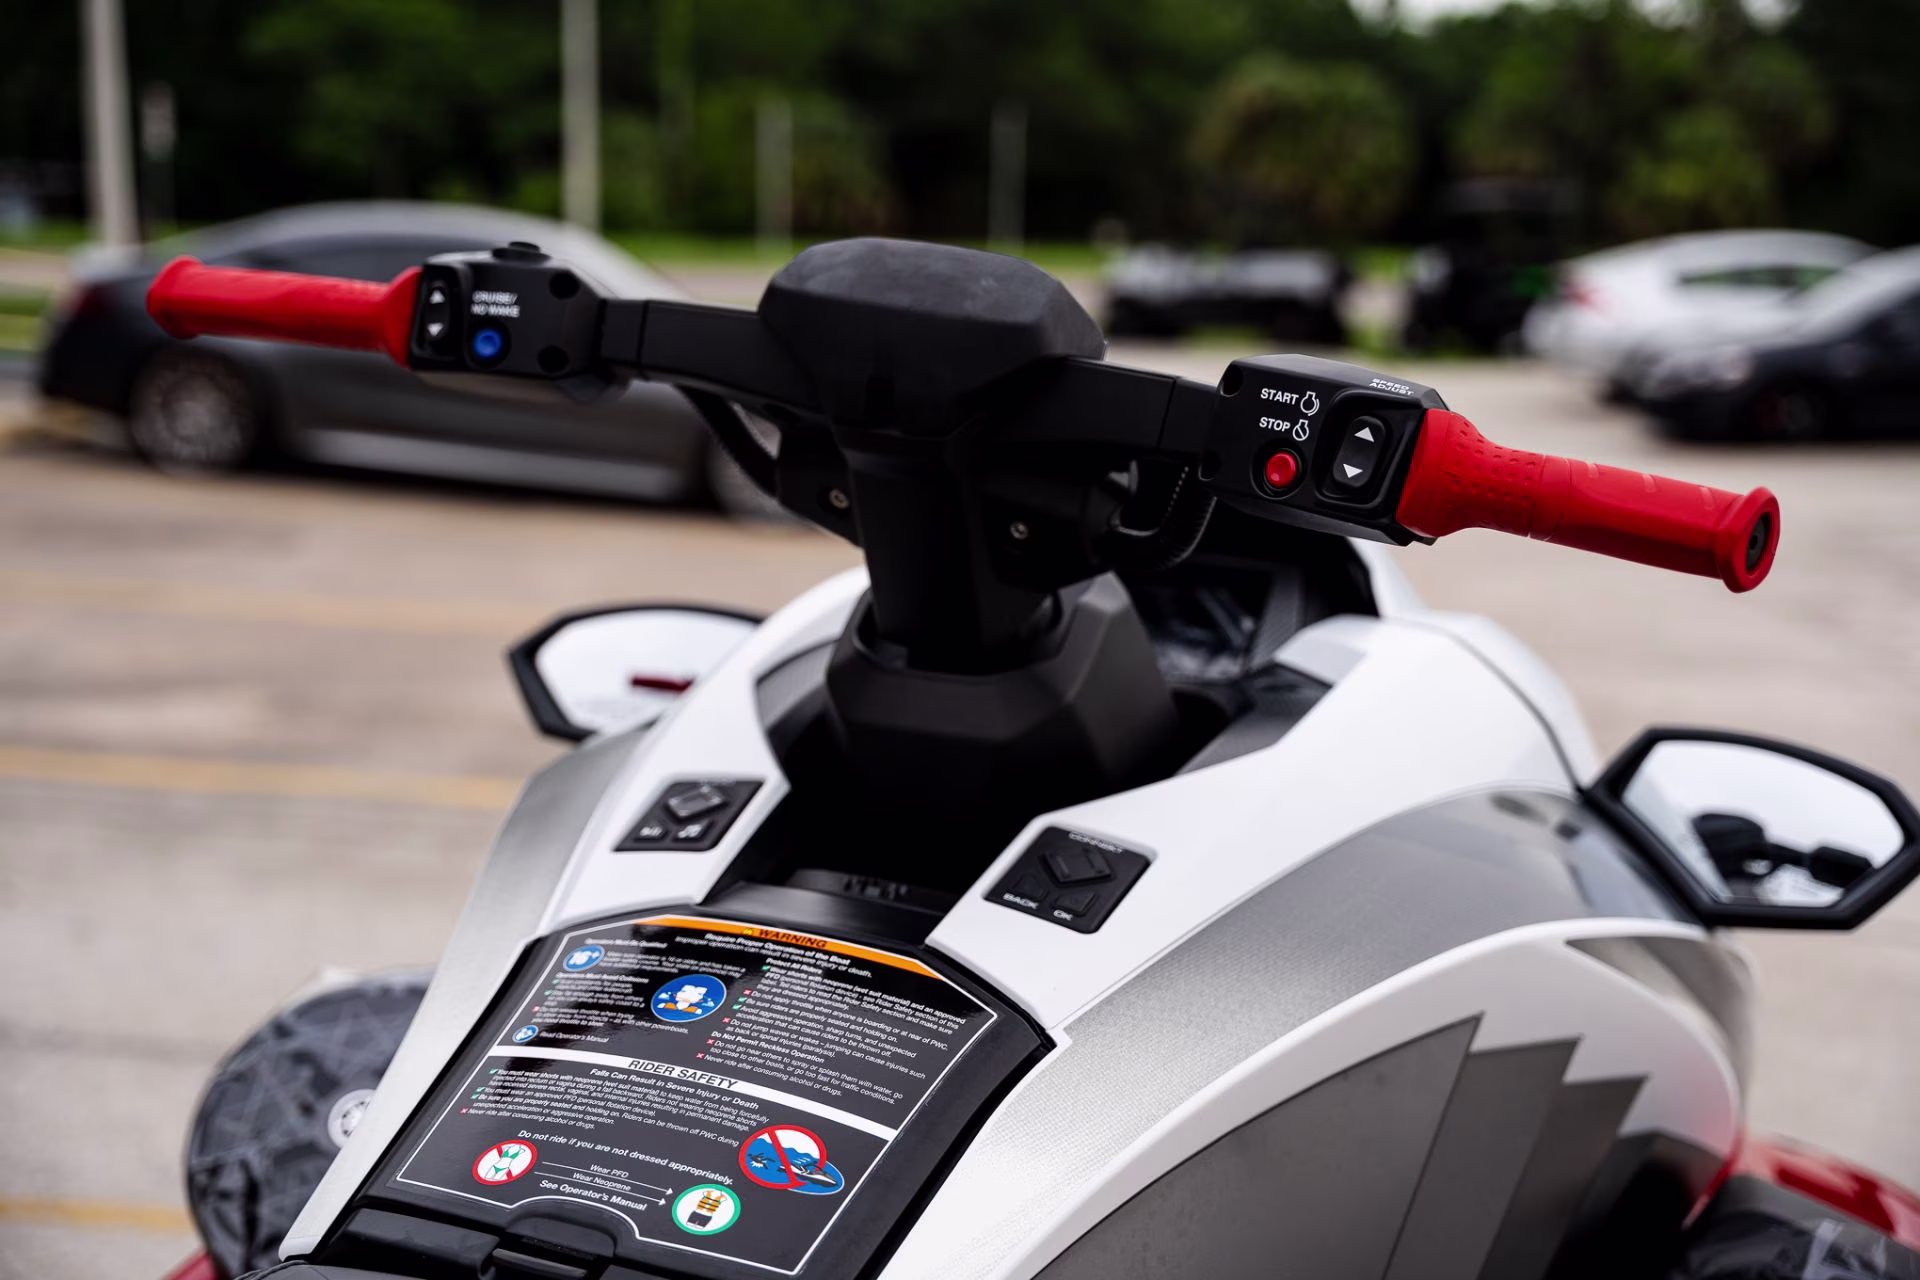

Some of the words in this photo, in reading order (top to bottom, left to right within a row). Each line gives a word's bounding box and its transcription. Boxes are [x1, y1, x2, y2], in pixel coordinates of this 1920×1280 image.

[472, 290, 517, 304] CRUISE/
[471, 303, 488, 315] NO
[489, 304, 520, 317] WAKE
[1261, 388, 1299, 405] START
[1369, 383, 1414, 395] ADJUST
[1372, 379, 1409, 390] SPEED
[1259, 417, 1291, 432] STOP
[1003, 893, 1039, 909] BACK
[1053, 910, 1073, 921] OK
[704, 932, 736, 943] Require
[735, 936, 764, 947] Proper
[763, 941, 805, 955] Operation
[814, 951, 829, 960] the
[828, 954, 851, 965] Boat
[757, 929, 828, 949] WARNING
[750, 990, 762, 998] Do
[772, 995, 791, 1005] apply
[790, 999, 814, 1009] throttle
[813, 1005, 832, 1014] when
[831, 1010, 856, 1020] anyone
[862, 1017, 892, 1032] boarding
[907, 1032, 922, 1041] rear
[929, 1039, 948, 1051] PWC.
[710, 1030, 722, 1038] Do
[721, 1032, 736, 1041] Not
[734, 1035, 759, 1046] Permit
[757, 1041, 790, 1053] Reckless
[790, 1048, 825, 1063] Operation
[627, 1059, 675, 1075] RIDER
[677, 1068, 738, 1088] SAFETY
[703, 1053, 724, 1063] Never
[736, 1062, 753, 1070] after
[752, 1066, 789, 1081] consuming
[788, 1075, 814, 1086] alcohol
[821, 1085, 842, 1096] drugs.
[709, 1046, 722, 1054] too
[720, 1049, 740, 1058] close
[738, 1052, 748, 1060] to
[746, 1055, 765, 1064] other
[793, 1067, 805, 1075] go
[803, 1070, 817, 1078] too
[816, 1073, 830, 1082] fast
[829, 1077, 841, 1085] for
[840, 1081, 860, 1092] traffic
[859, 1088, 895, 1104] conditions.
[713, 1039, 725, 1047] Do
[745, 1047, 762, 1055] near
[760, 1051, 783, 1061] others
[790, 1059, 810, 1069] spray
[817, 1066, 840, 1077] splash
[839, 1073, 858, 1083] them
[857, 1079, 873, 1088] with
[892, 1091, 903, 1099] go
[589, 1068, 610, 1077] Falls
[610, 1071, 628, 1080] Can
[627, 1074, 656, 1085] Result
[665, 1081, 695, 1093] Severe
[695, 1088, 721, 1100] Injury
[731, 1096, 759, 1110] Death
[522, 1097, 550, 1107] properly
[549, 1101, 573, 1109] seated
[584, 1105, 610, 1116] holding
[620, 1112, 643, 1122] Riders
[642, 1117, 656, 1125] can
[655, 1119, 666, 1127] be
[665, 1122, 689, 1132] thrown
[698, 1129, 718, 1140] PWC
[716, 1135, 739, 1147] during
[517, 1129, 532, 1138] Do
[531, 1133, 549, 1141] not
[548, 1134, 567, 1144] ride
[567, 1137, 577, 1145] if
[574, 1140, 594, 1149] you
[594, 1144, 611, 1152] are
[610, 1147, 629, 1156] not
[628, 1151, 669, 1165] dressed
[668, 1161, 733, 1185] appropriately.
[572, 1172, 593, 1182] Wear
[591, 1176, 631, 1192] Neoprene
[589, 1163, 610, 1174] Wear
[610, 1168, 629, 1178] PFD
[538, 1179, 558, 1190] See
[559, 1183, 609, 1201] Operator's
[609, 1194, 647, 1211] Manual
